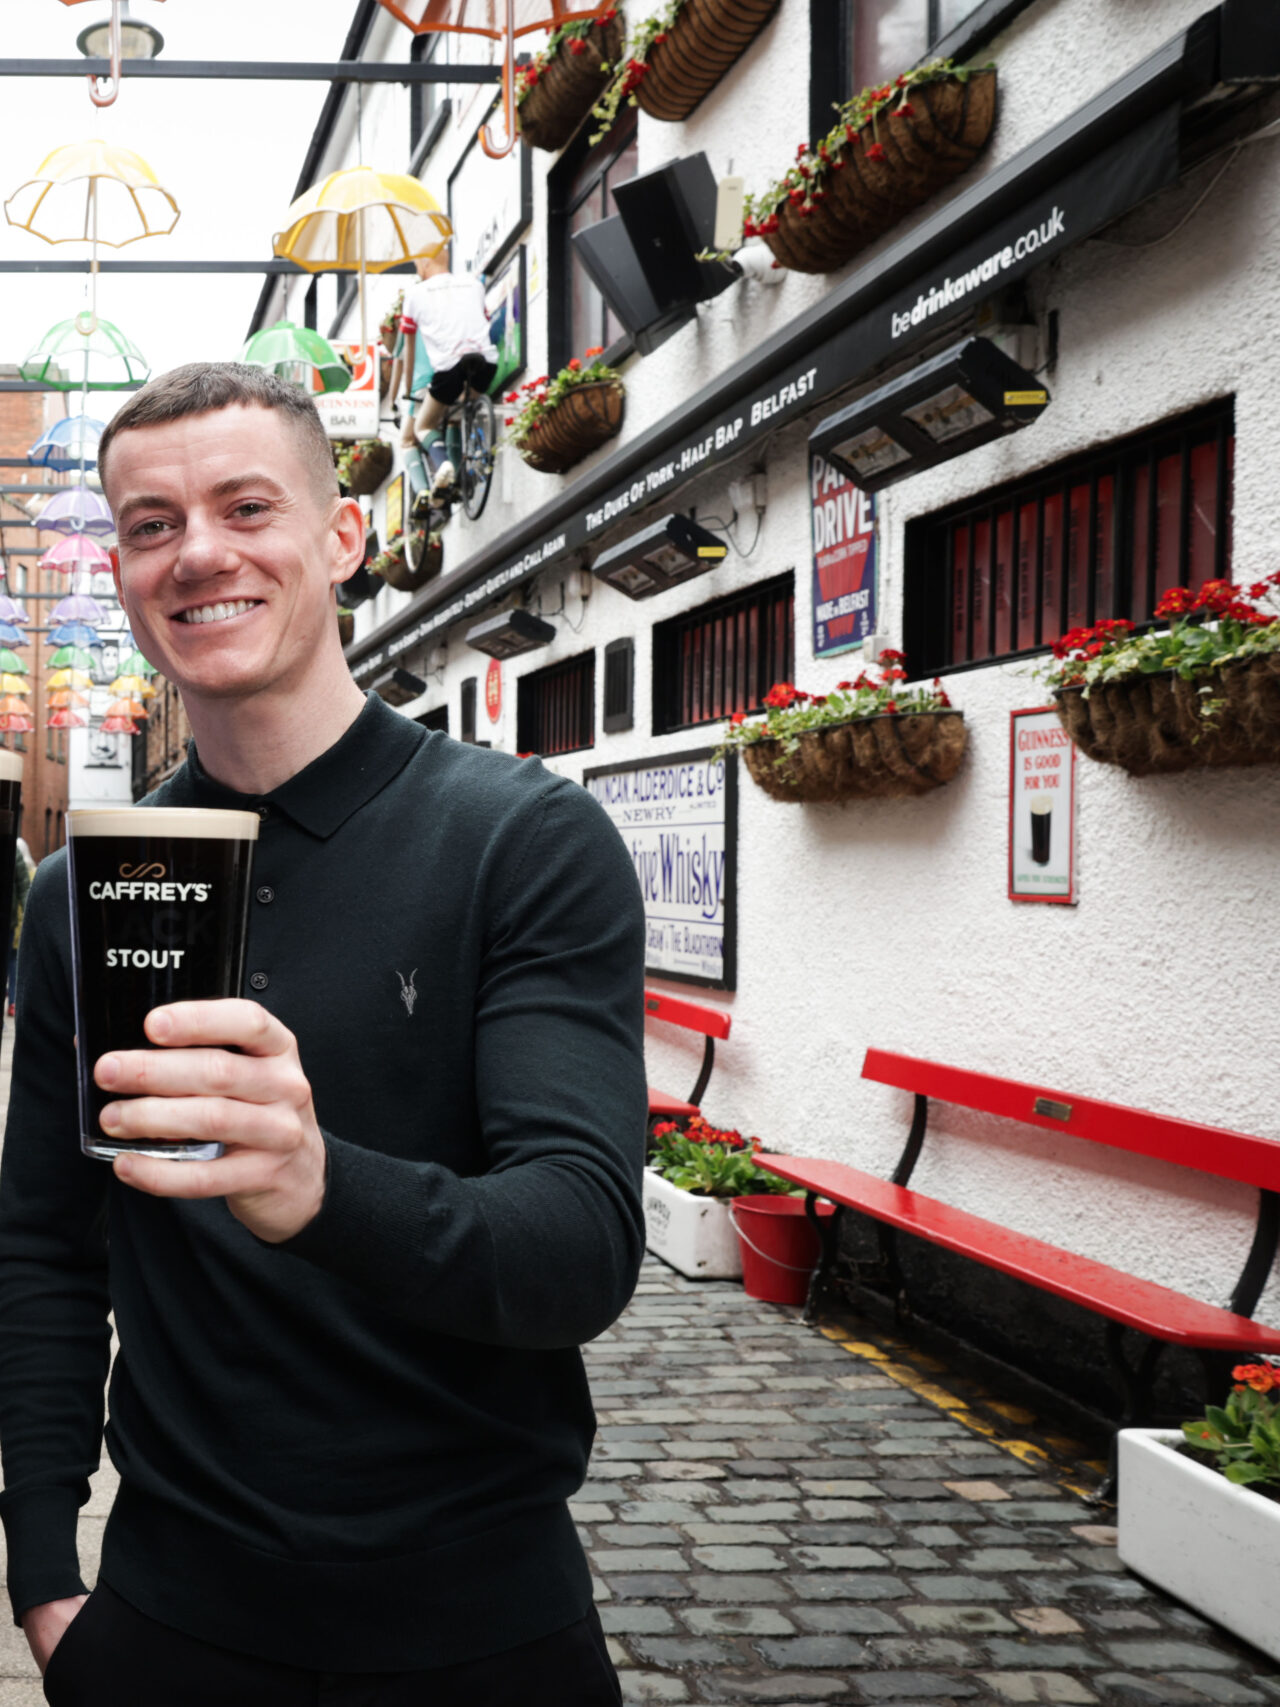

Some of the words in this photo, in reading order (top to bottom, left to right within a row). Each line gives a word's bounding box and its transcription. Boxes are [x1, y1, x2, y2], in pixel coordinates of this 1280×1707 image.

[330, 414, 357, 426] BAR
[586, 507, 603, 531] THE
[604, 492, 630, 521] DUKE
[630, 481, 645, 503] OF
[646, 462, 675, 492] YORK
[681, 437, 714, 472] HALF
[715, 418, 743, 450] BAP
[751, 368, 817, 426] BELFAST
[813, 487, 873, 553] DRIVE
[524, 549, 542, 571] CALL
[542, 533, 566, 560] AGAIN
[1018, 727, 1070, 751] GUINNESS
[1024, 757, 1032, 770] IS
[1035, 753, 1061, 770] GOOD
[1024, 775, 1040, 790] FOR
[1043, 773, 1060, 788] YOU
[623, 805, 676, 822] NEWRY
[632, 838, 659, 902] tive
[660, 833, 725, 919] Whisky
[89, 881, 210, 902] CAFFREY'S
[106, 948, 185, 969] STOUT
